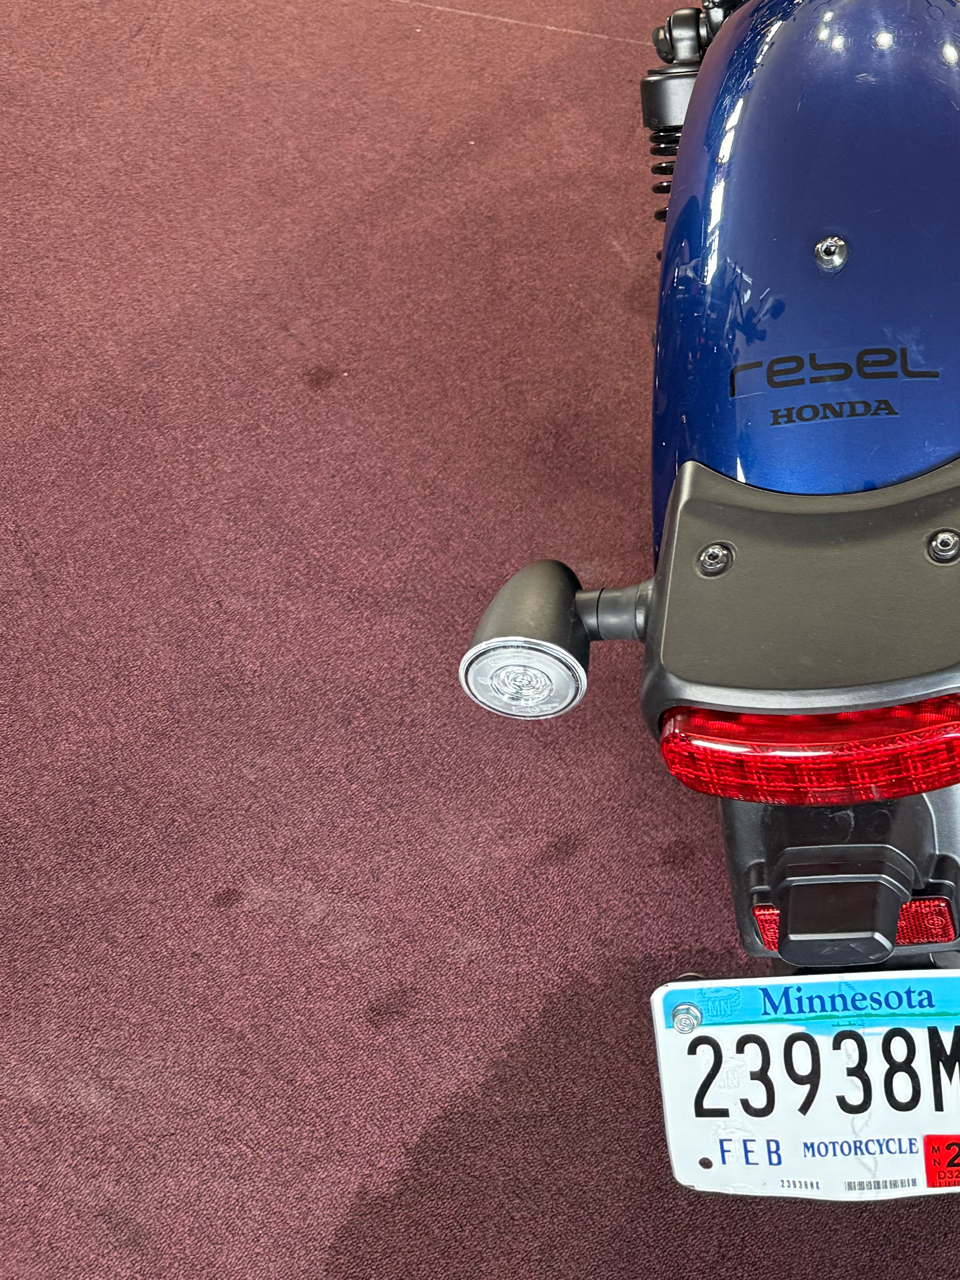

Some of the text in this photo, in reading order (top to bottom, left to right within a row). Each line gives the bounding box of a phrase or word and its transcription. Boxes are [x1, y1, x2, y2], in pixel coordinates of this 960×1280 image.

[770, 400, 898, 426] HONDA
[759, 986, 935, 1016] Minnesota
[719, 1139, 782, 1166] FEB
[803, 1138, 919, 1158] MOTORCYCLE
